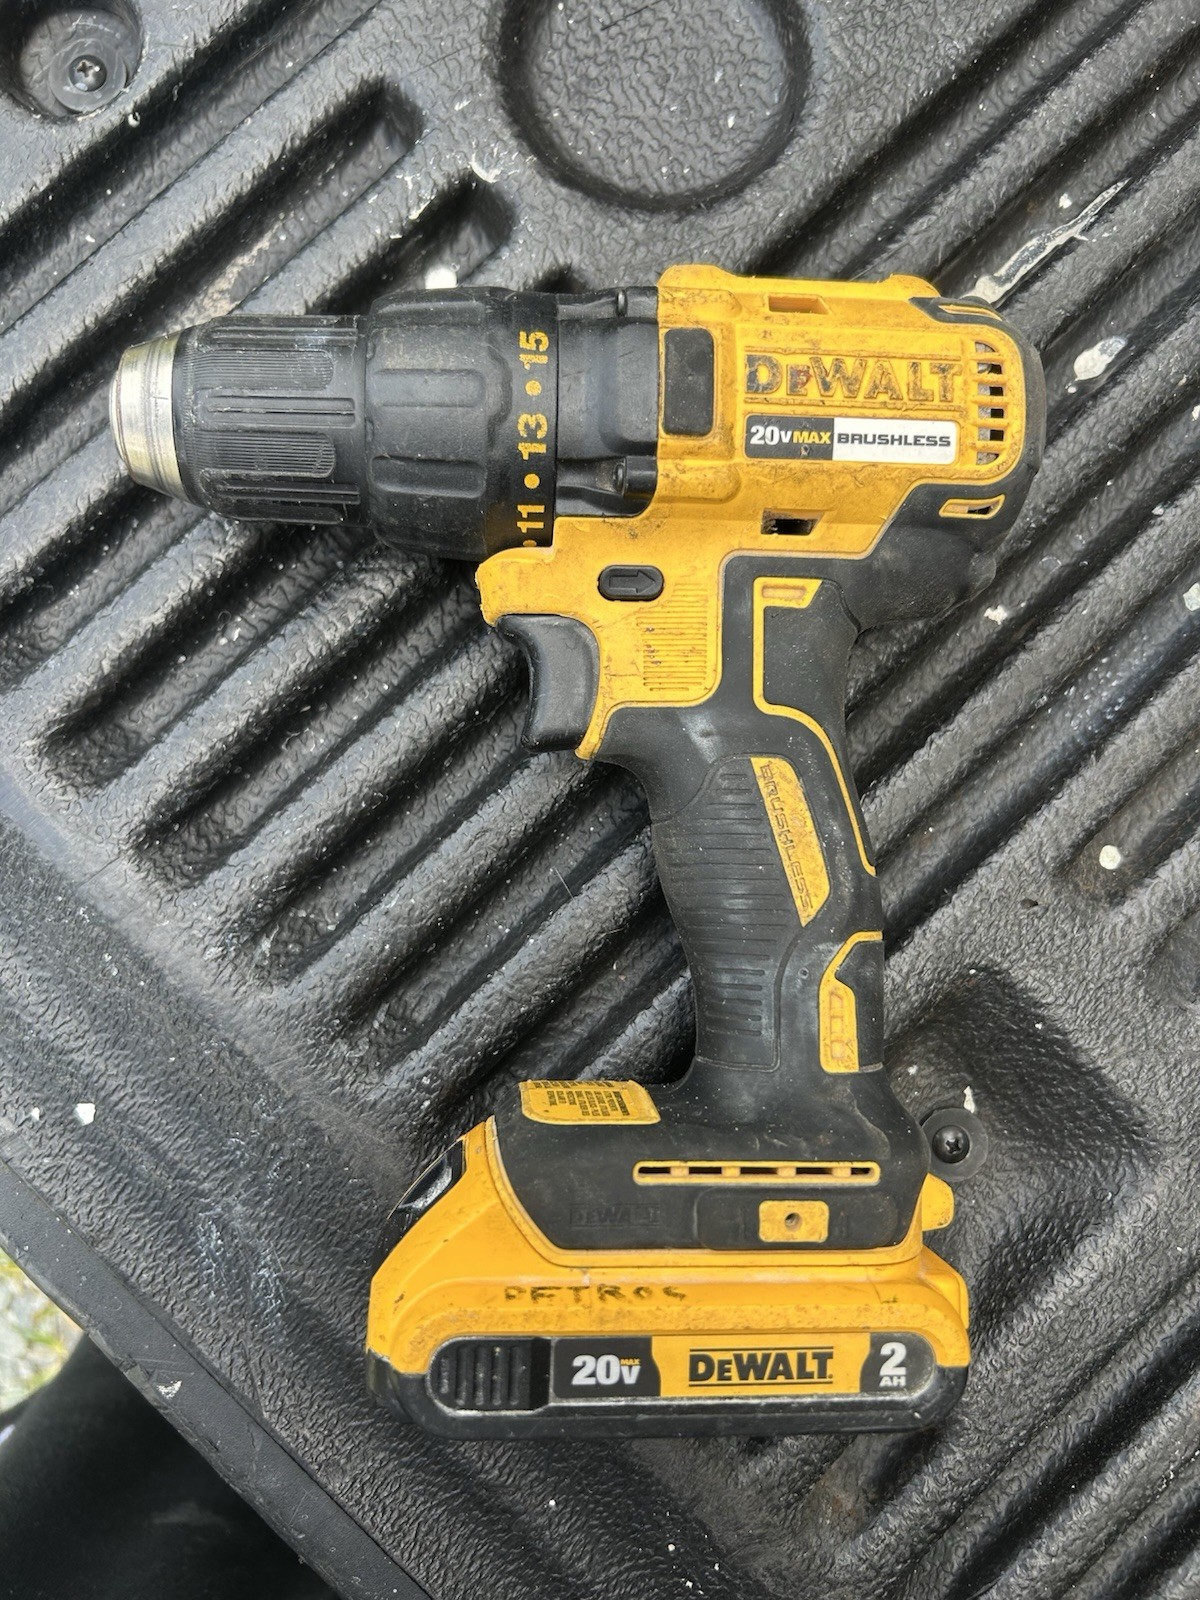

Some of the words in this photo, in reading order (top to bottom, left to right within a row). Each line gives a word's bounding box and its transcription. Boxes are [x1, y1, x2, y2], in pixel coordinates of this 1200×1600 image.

[519, 331, 549, 370] 15
[517, 413, 548, 461] 13
[836, 432, 951, 448] BRUSHLESS
[516, 505, 545, 533] 11
[760, 764, 813, 911] BRUSHLESS
[571, 1354, 641, 1385] 20V
[879, 1342, 907, 1376] 2
[879, 1375, 907, 1388] AH
